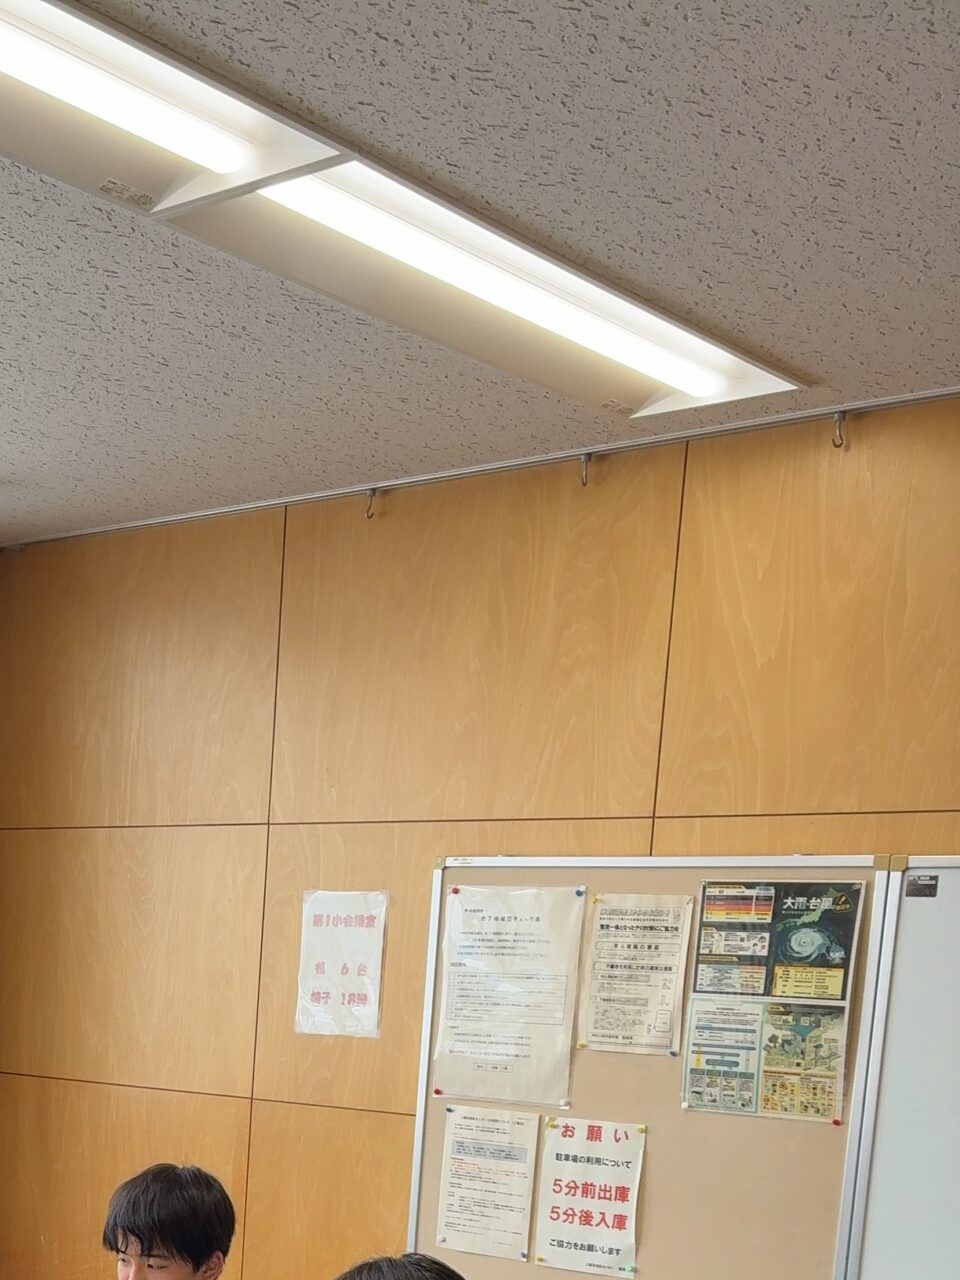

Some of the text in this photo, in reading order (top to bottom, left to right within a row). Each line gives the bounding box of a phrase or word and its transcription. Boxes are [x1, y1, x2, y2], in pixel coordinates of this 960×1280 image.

[561, 1122, 629, 1143] お願い
[555, 1152, 632, 1169] 駐車場の利用について
[552, 1178, 631, 1204] 5分前出庫
[550, 1205, 629, 1231] 5分後入庫
[549, 1238, 622, 1256] ご協力をお願いします
